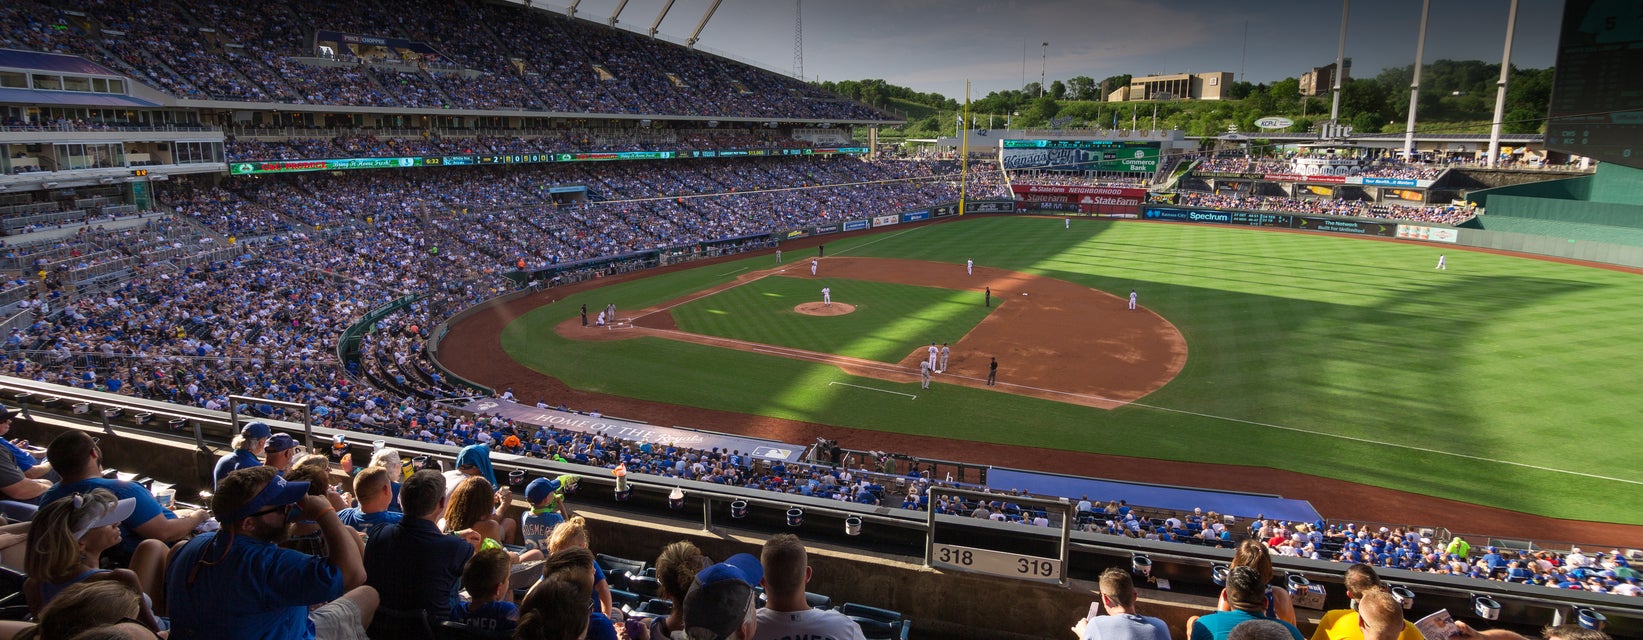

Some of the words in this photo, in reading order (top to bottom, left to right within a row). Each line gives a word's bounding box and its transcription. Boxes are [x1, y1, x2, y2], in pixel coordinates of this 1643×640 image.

[361, 36, 385, 44] CHOPPER
[977, 129, 987, 137] 42
[1118, 129, 1130, 138] 20
[1139, 129, 1149, 138] 10
[1160, 129, 1167, 138] 5
[1321, 122, 1353, 140] lite
[1004, 152, 1046, 169] Kansas
[1047, 148, 1072, 164] City
[1068, 187, 1122, 195] NEIGHBORHOOD
[1189, 211, 1228, 221] Spectrum
[535, 413, 590, 428] HOME
[590, 422, 617, 432] OF
[618, 426, 657, 439] THE
[657, 433, 704, 444] Royals
[939, 547, 974, 566] 318
[1017, 557, 1053, 577] 319
